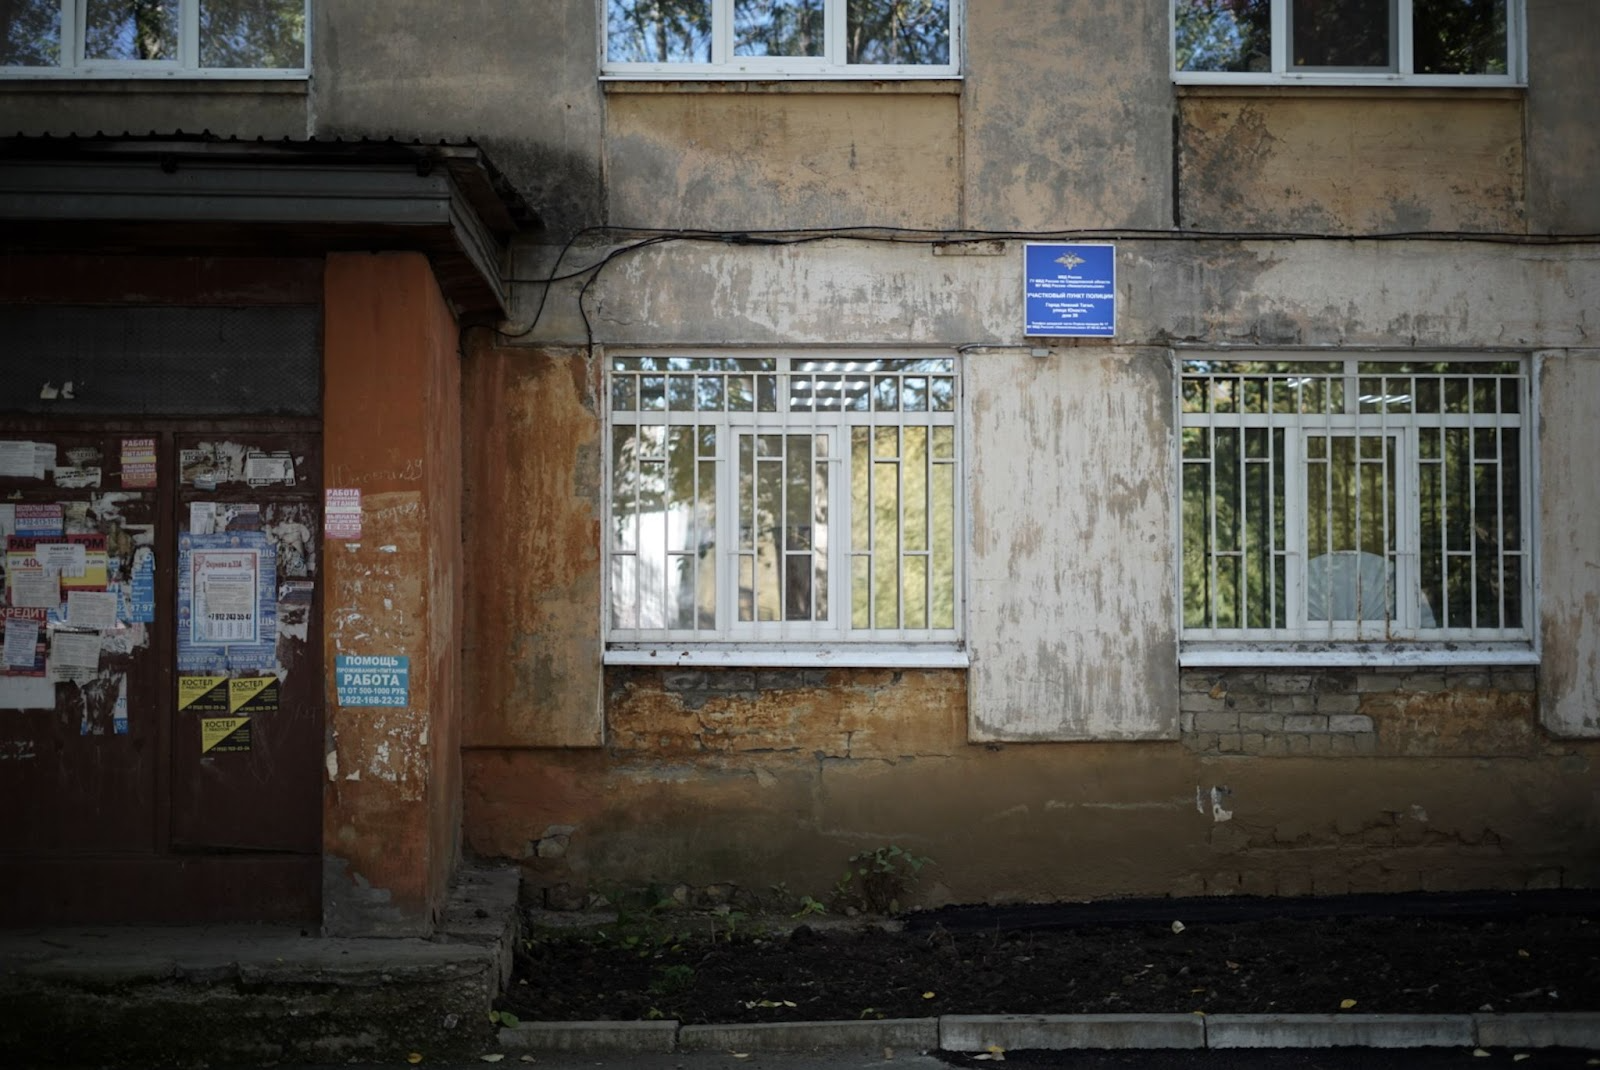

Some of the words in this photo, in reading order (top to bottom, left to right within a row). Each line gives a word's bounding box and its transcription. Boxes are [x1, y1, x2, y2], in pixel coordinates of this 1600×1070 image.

[122, 439, 155, 447] РАБОТА
[0, 608, 46, 619] КРЕДИТ
[345, 656, 398, 668] ПОМОЩЬ
[232, 680, 264, 689] ХОСТЕЛ
[344, 674, 400, 686] РАБОТА
[205, 720, 237, 728] ХОСТЕЛ
